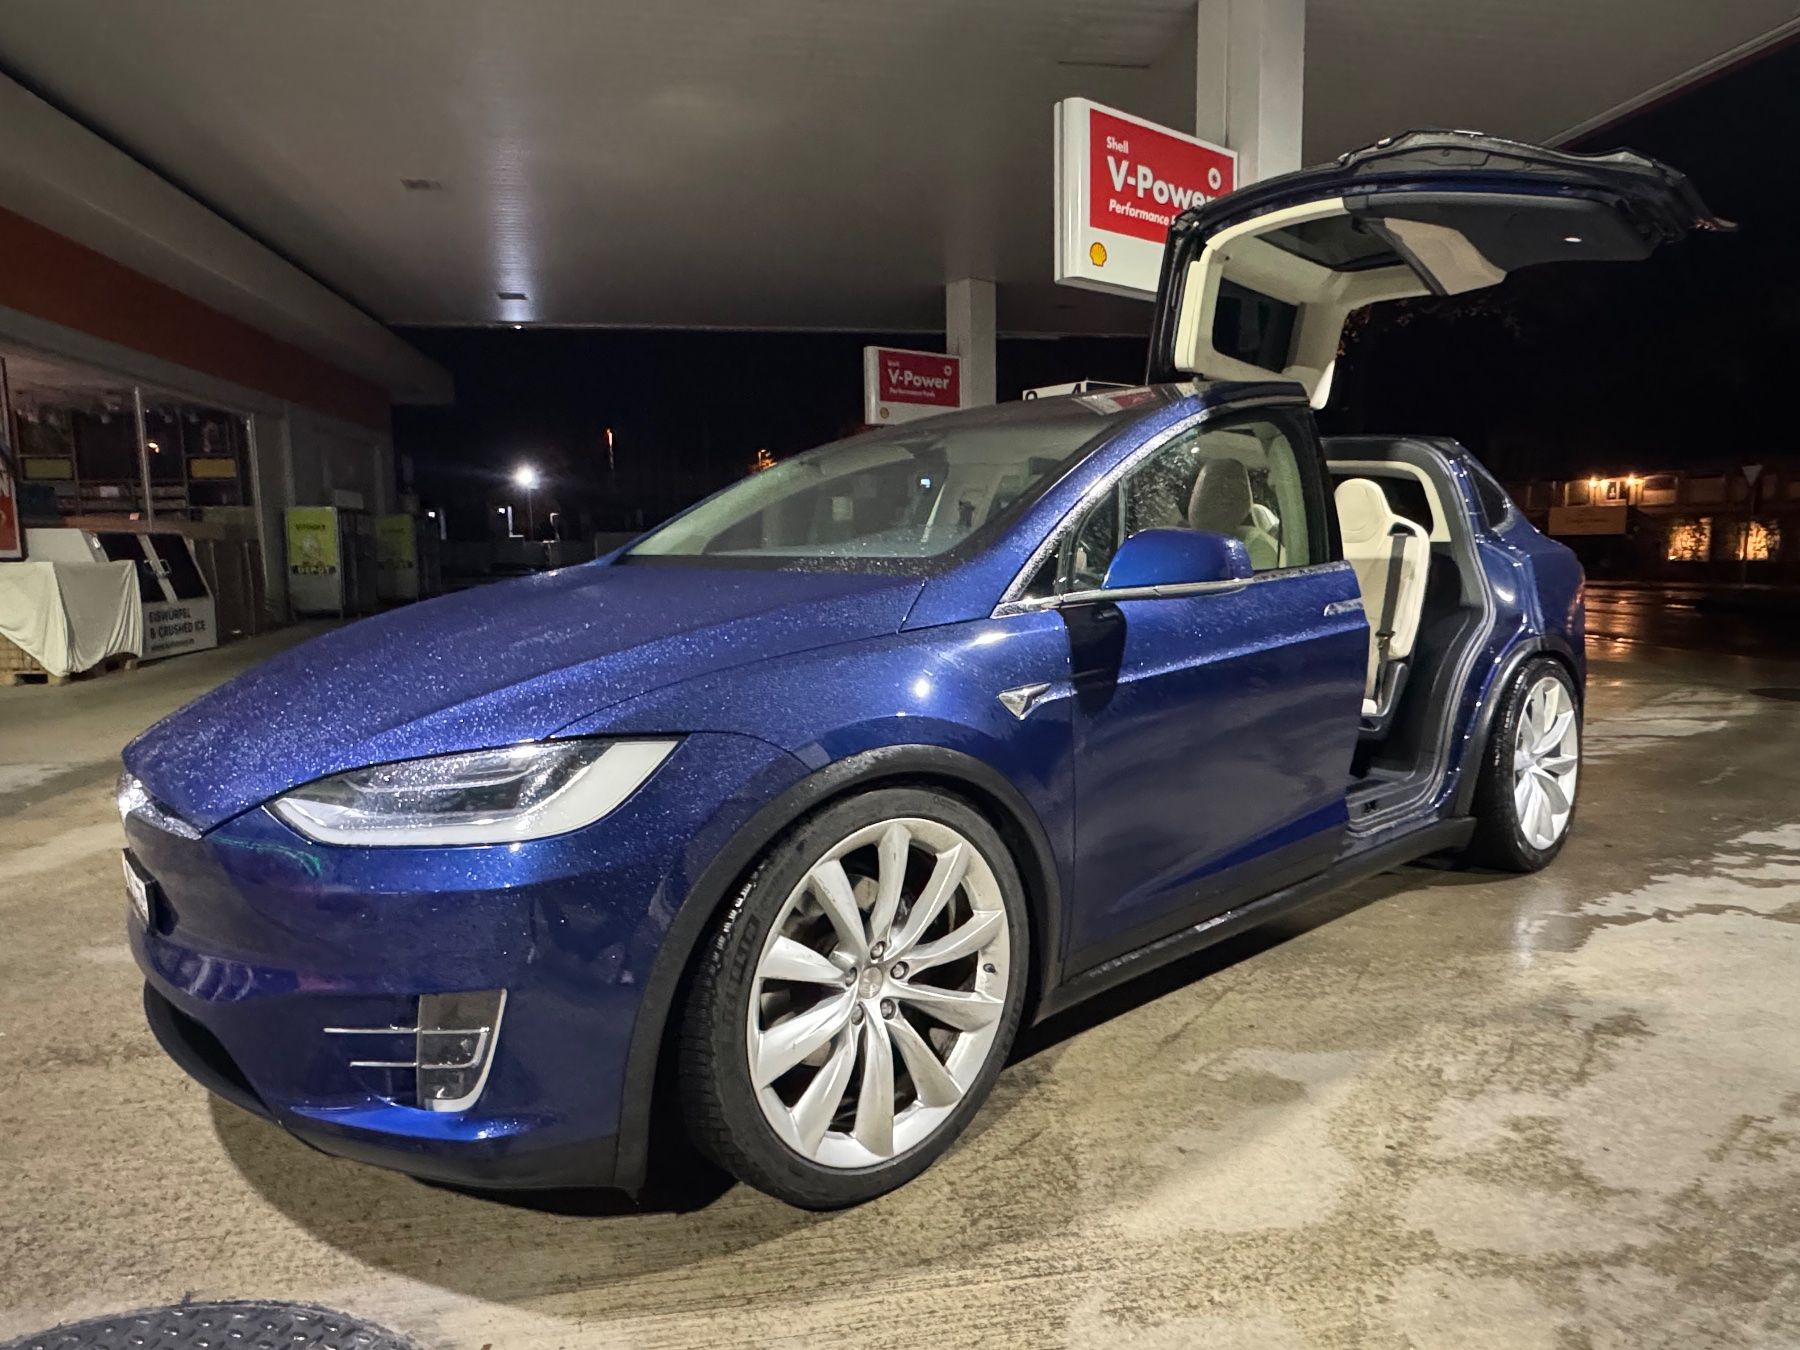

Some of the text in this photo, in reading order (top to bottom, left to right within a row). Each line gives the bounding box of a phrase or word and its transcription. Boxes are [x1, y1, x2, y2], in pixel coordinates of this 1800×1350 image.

[1106, 136, 1129, 154] Shell
[1108, 198, 1170, 226] Performance
[887, 368, 950, 389] V-Power
[158, 622, 194, 639] CRUSHED
